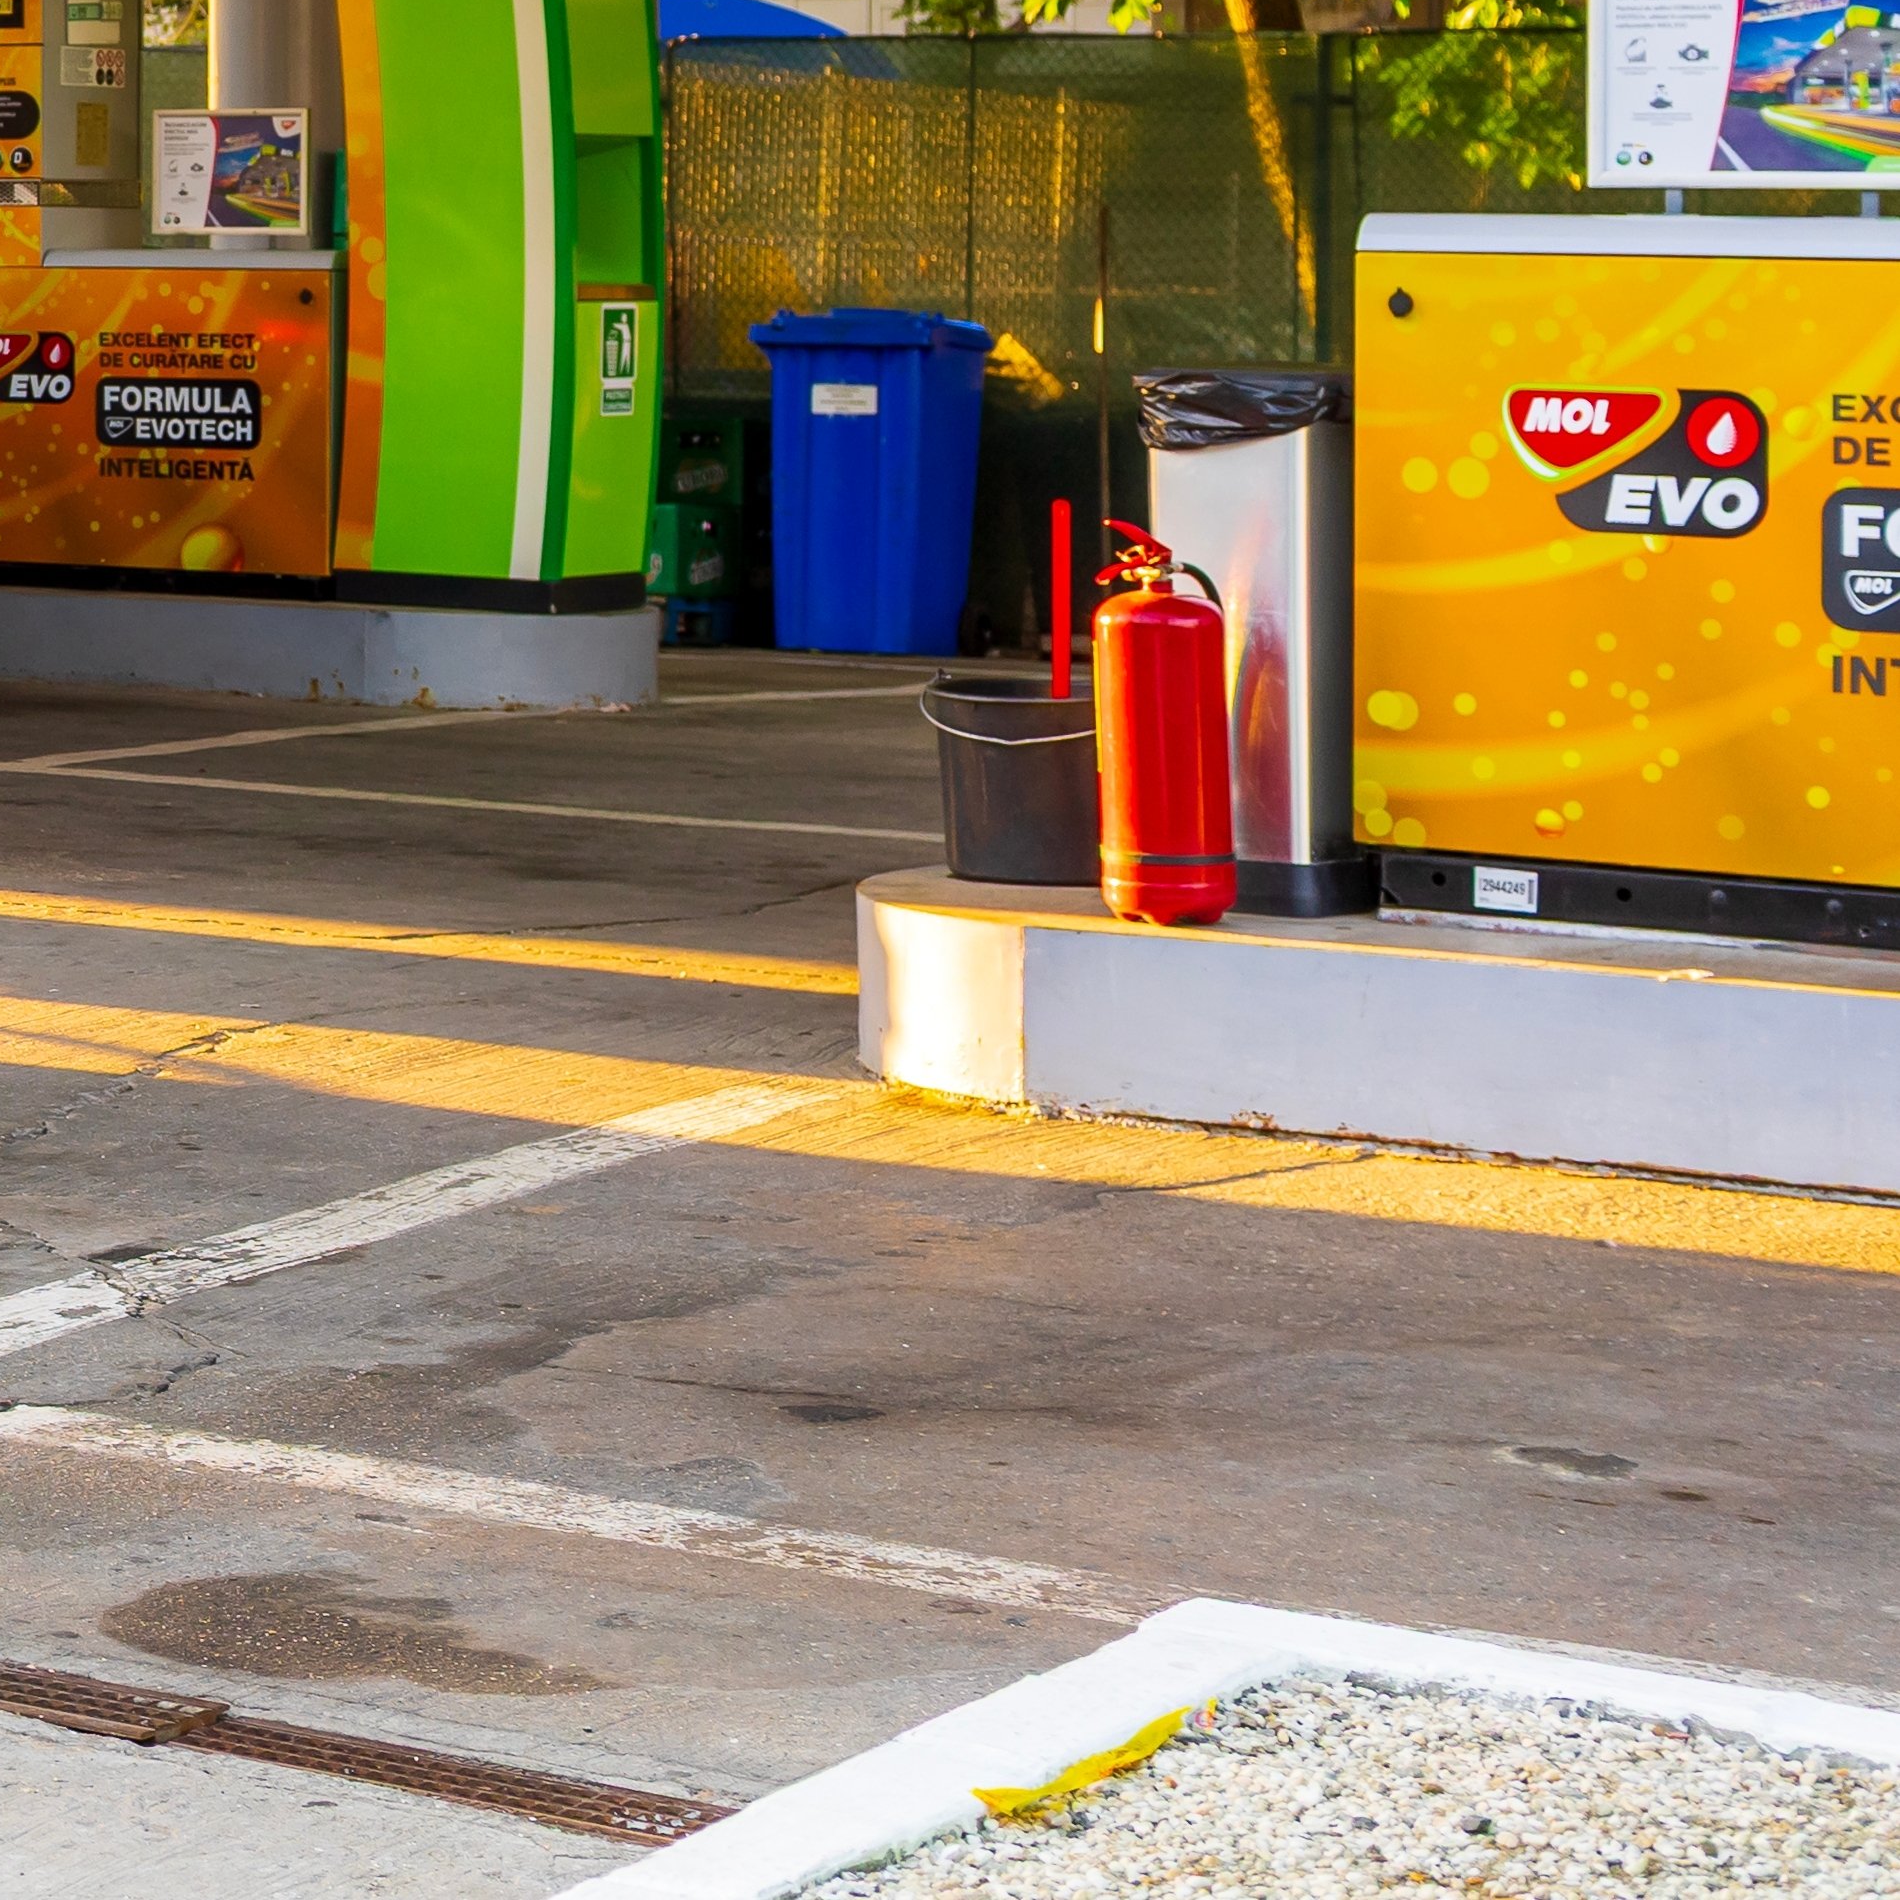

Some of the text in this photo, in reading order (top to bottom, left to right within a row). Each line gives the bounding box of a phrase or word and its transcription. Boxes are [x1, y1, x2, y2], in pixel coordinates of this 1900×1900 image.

[99, 332, 192, 348] EXCELENT
[197, 333, 256, 349] EFECT
[100, 349, 256, 373] DE CURĂȚARE CU
[9, 374, 72, 399] EVO
[104, 385, 253, 414] FORMULA
[136, 417, 253, 441] EVOTECH
[1523, 398, 1610, 435] MOL
[1834, 436, 1891, 466] DE
[100, 457, 255, 482] INTELIGENTĂ
[1605, 474, 1760, 528] EVO
[1855, 577, 1894, 595] MOL
